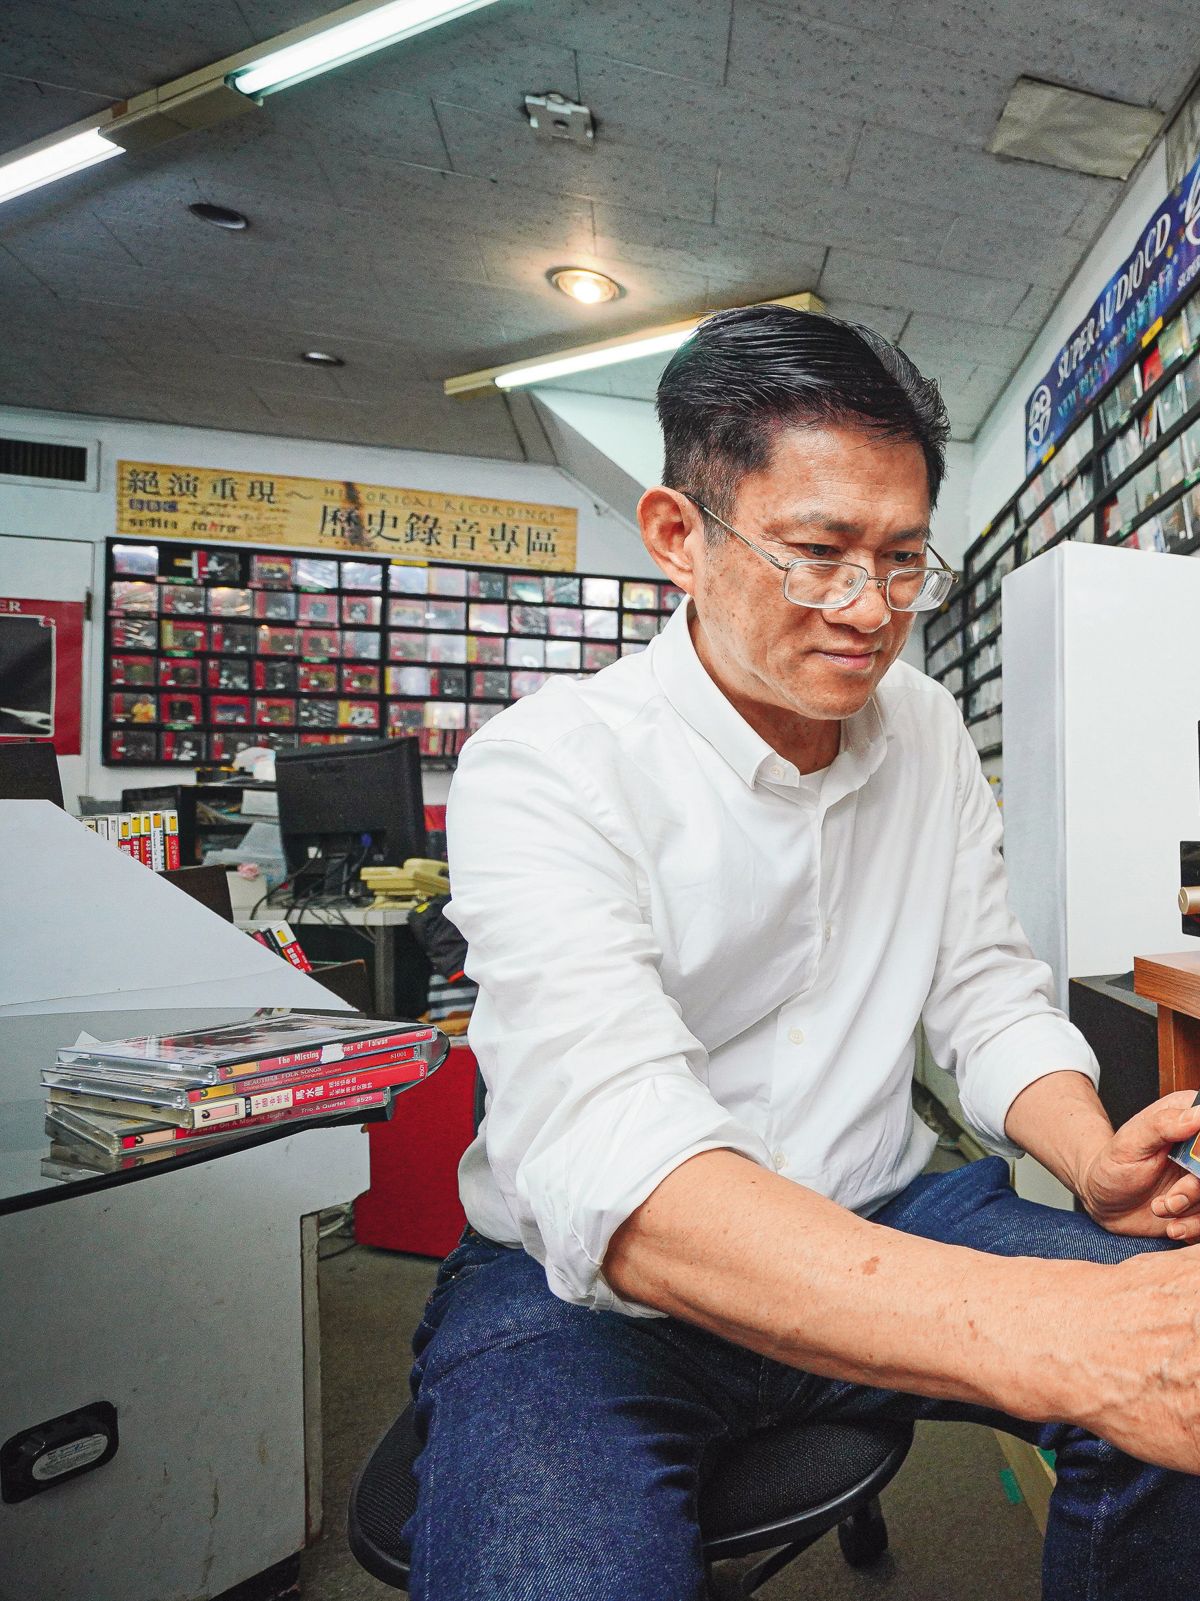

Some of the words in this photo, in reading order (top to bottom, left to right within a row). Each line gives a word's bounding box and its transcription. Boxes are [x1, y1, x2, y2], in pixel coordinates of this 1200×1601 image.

[1057, 318, 1096, 388] SUPER
[1097, 250, 1144, 336] AUDIO
[1144, 213, 1171, 269] CD
[320, 504, 560, 558] 歷史錄音專區
[278, 1055, 291, 1066] The
[294, 1050, 320, 1064] Missing
[368, 1037, 389, 1048] Taiwan
[295, 1085, 324, 1101] 馬水龍
[322, 1100, 347, 1111] Quartet
